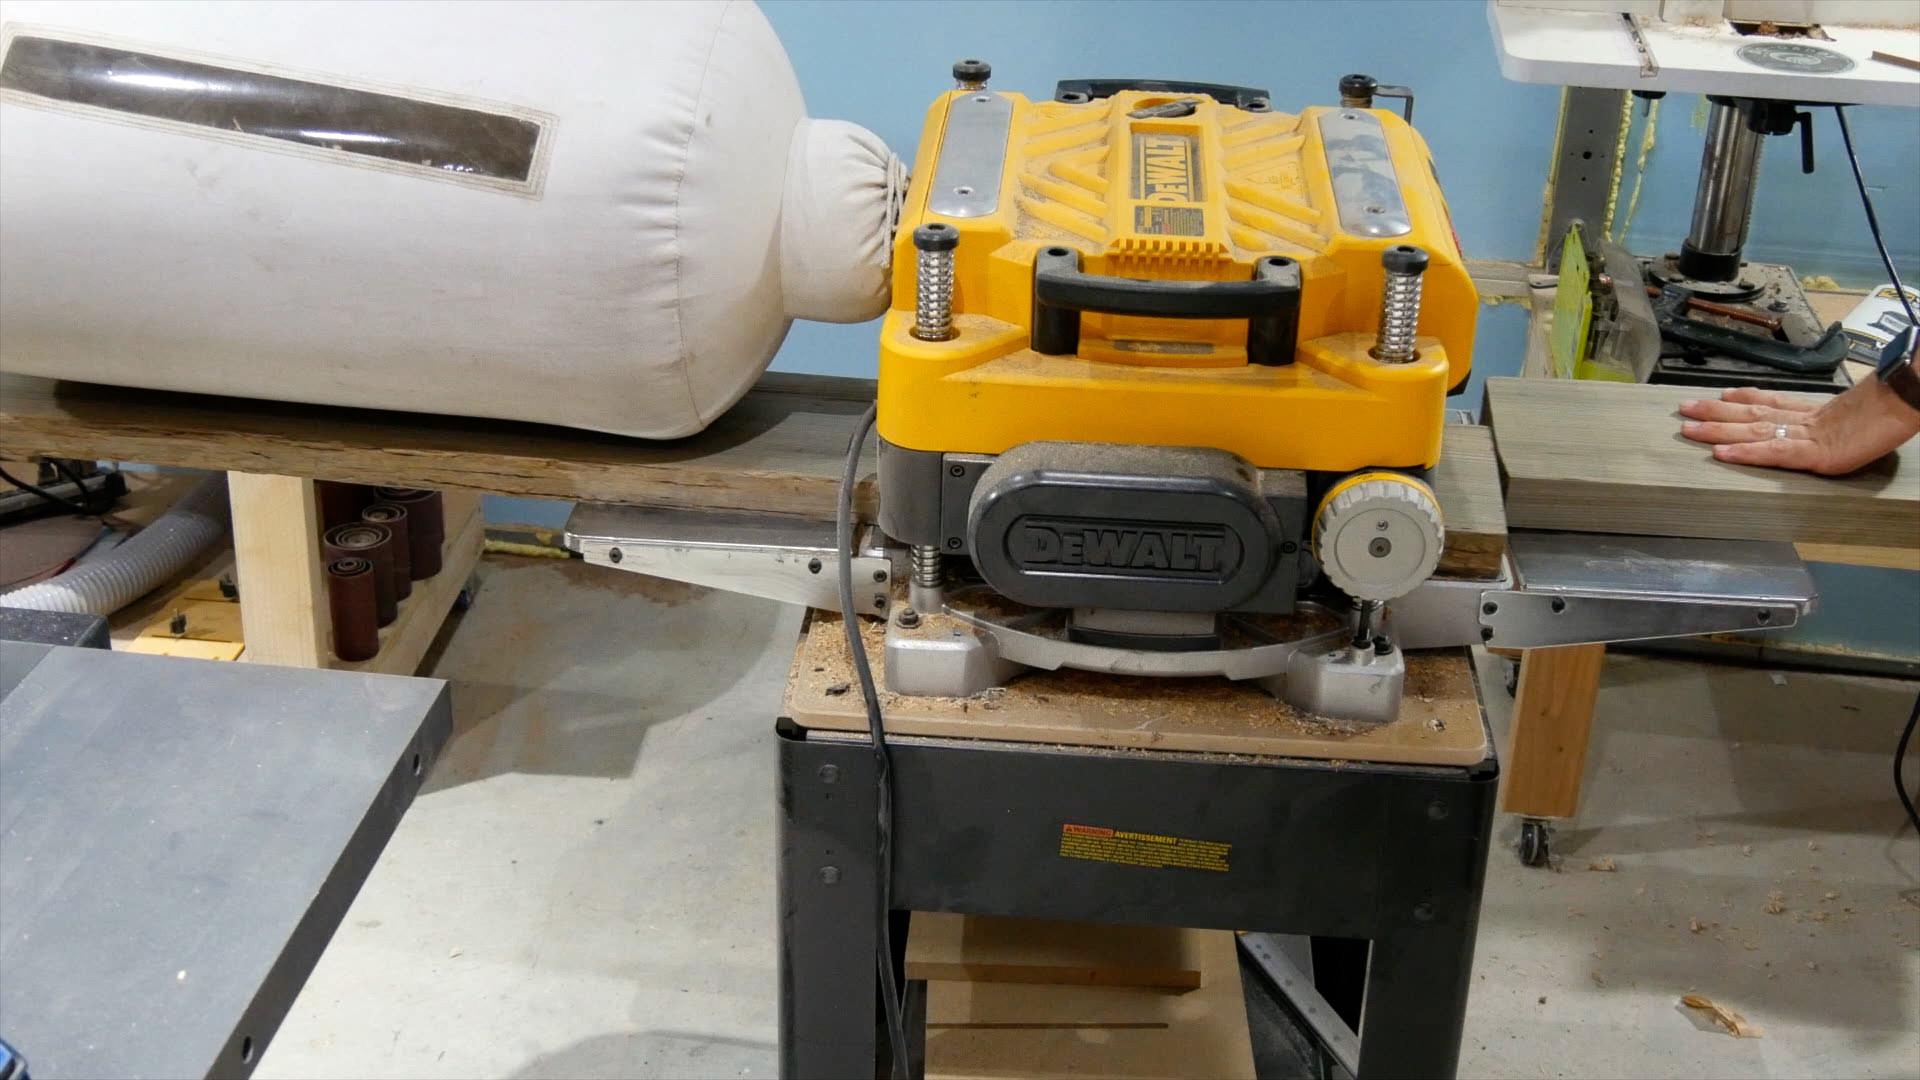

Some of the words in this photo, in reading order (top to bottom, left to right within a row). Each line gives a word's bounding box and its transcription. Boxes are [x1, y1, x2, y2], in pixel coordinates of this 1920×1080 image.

[1146, 136, 1188, 202] DEWALT
[1024, 526, 1225, 572] DEWALT
[1073, 826, 1112, 836] WARNING
[1115, 831, 1178, 845] AVERTISSEMENT
